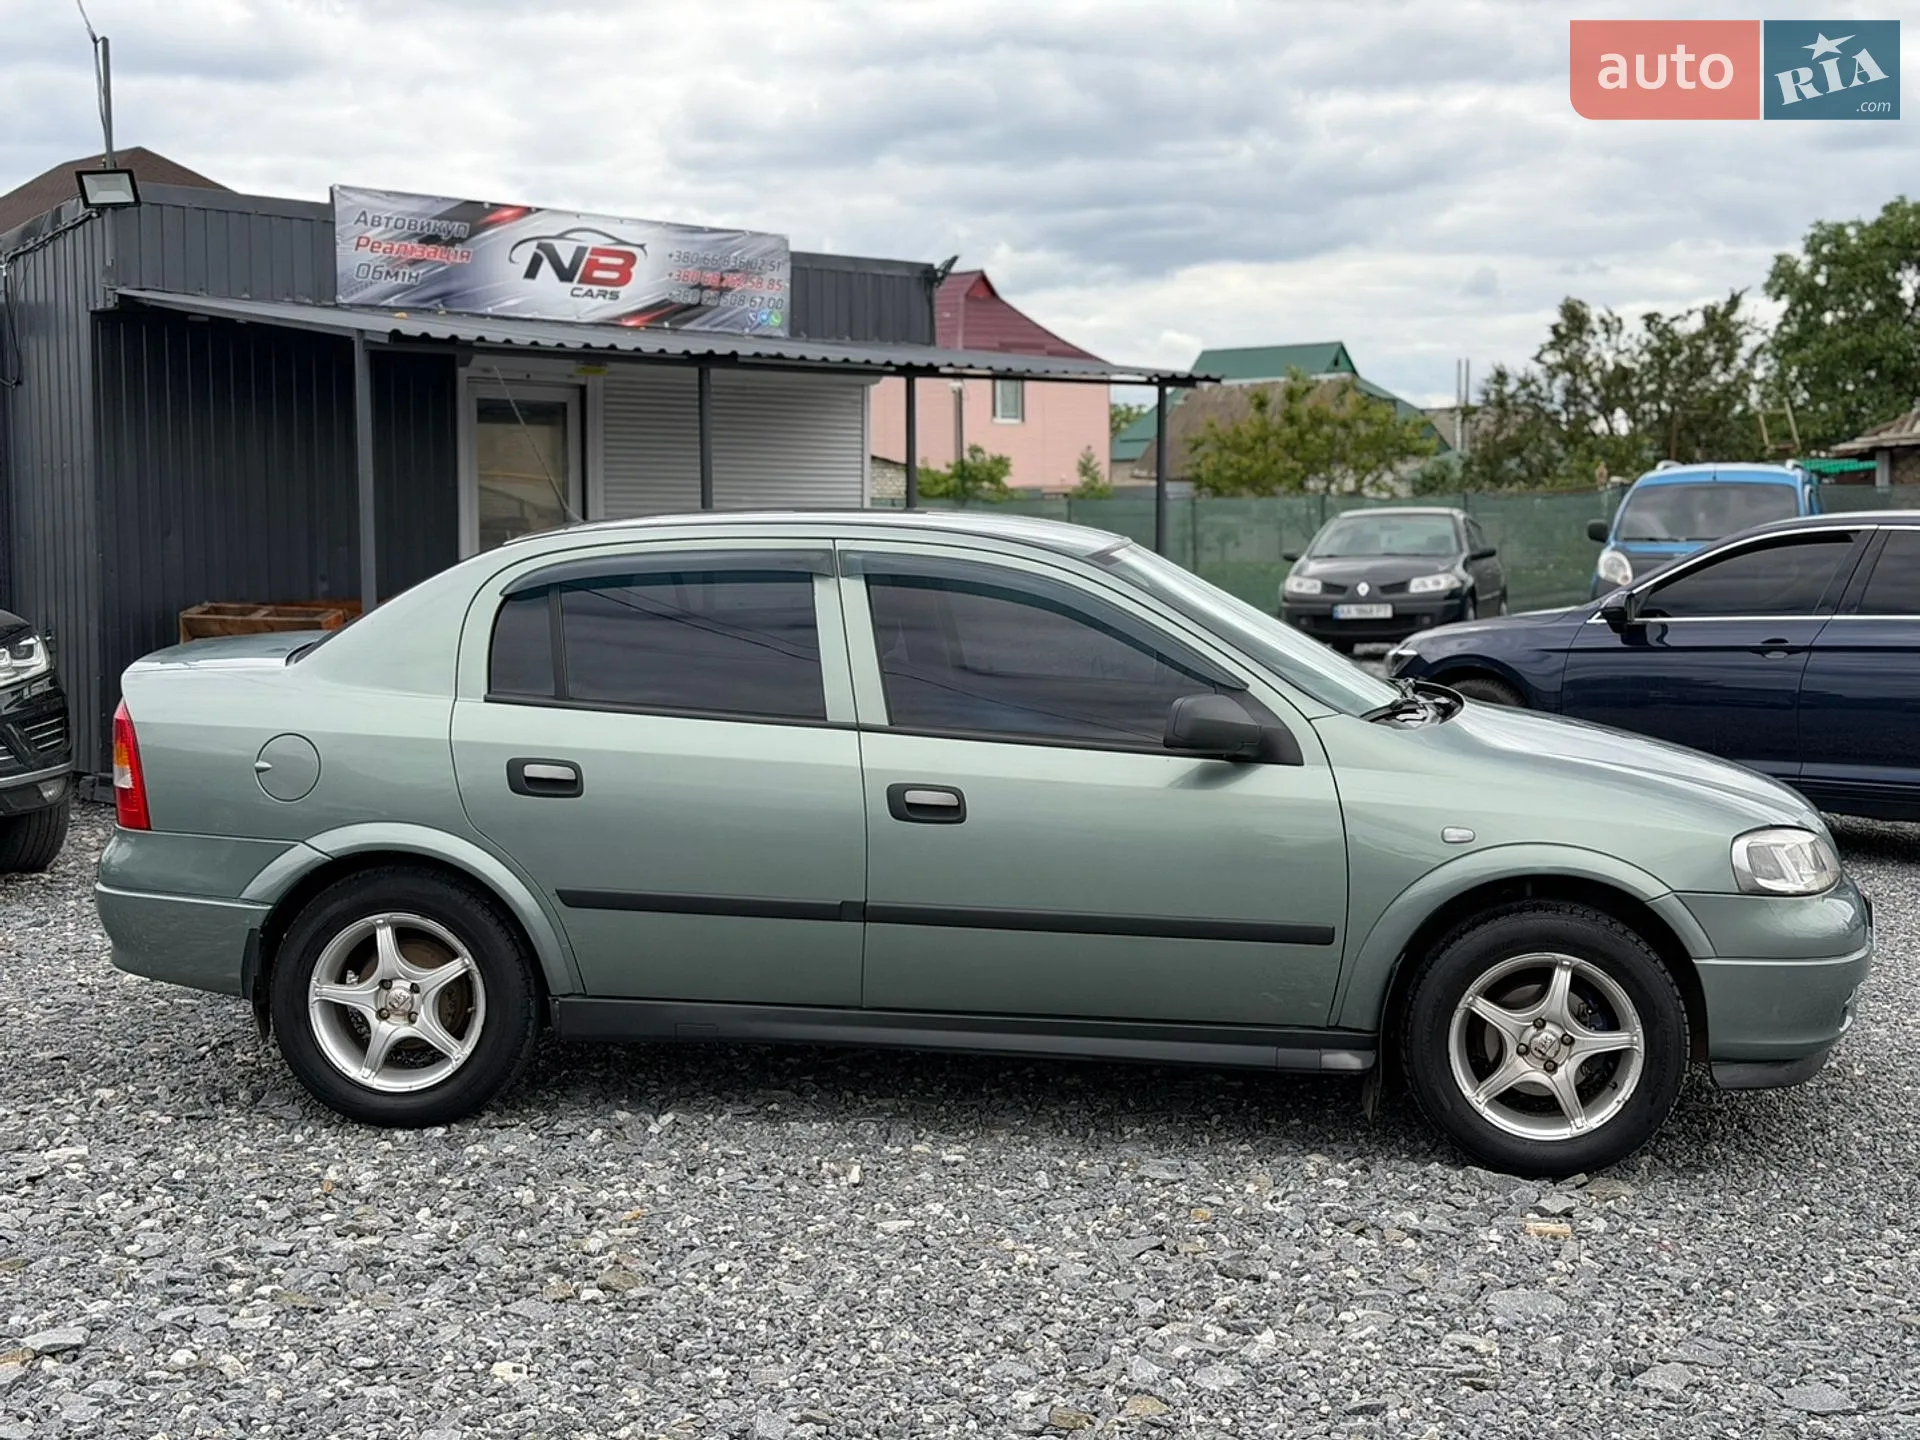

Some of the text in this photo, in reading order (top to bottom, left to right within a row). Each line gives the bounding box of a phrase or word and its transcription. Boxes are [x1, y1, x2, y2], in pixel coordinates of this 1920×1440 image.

[353, 209, 470, 239] Автовикуп
[354, 235, 472, 264] Реалізація
[355, 262, 420, 283] Обмін
[523, 241, 637, 288] NB
[570, 286, 620, 300] CARS
[749, 295, 765, 309] 67
[767, 297, 784, 310] 00
